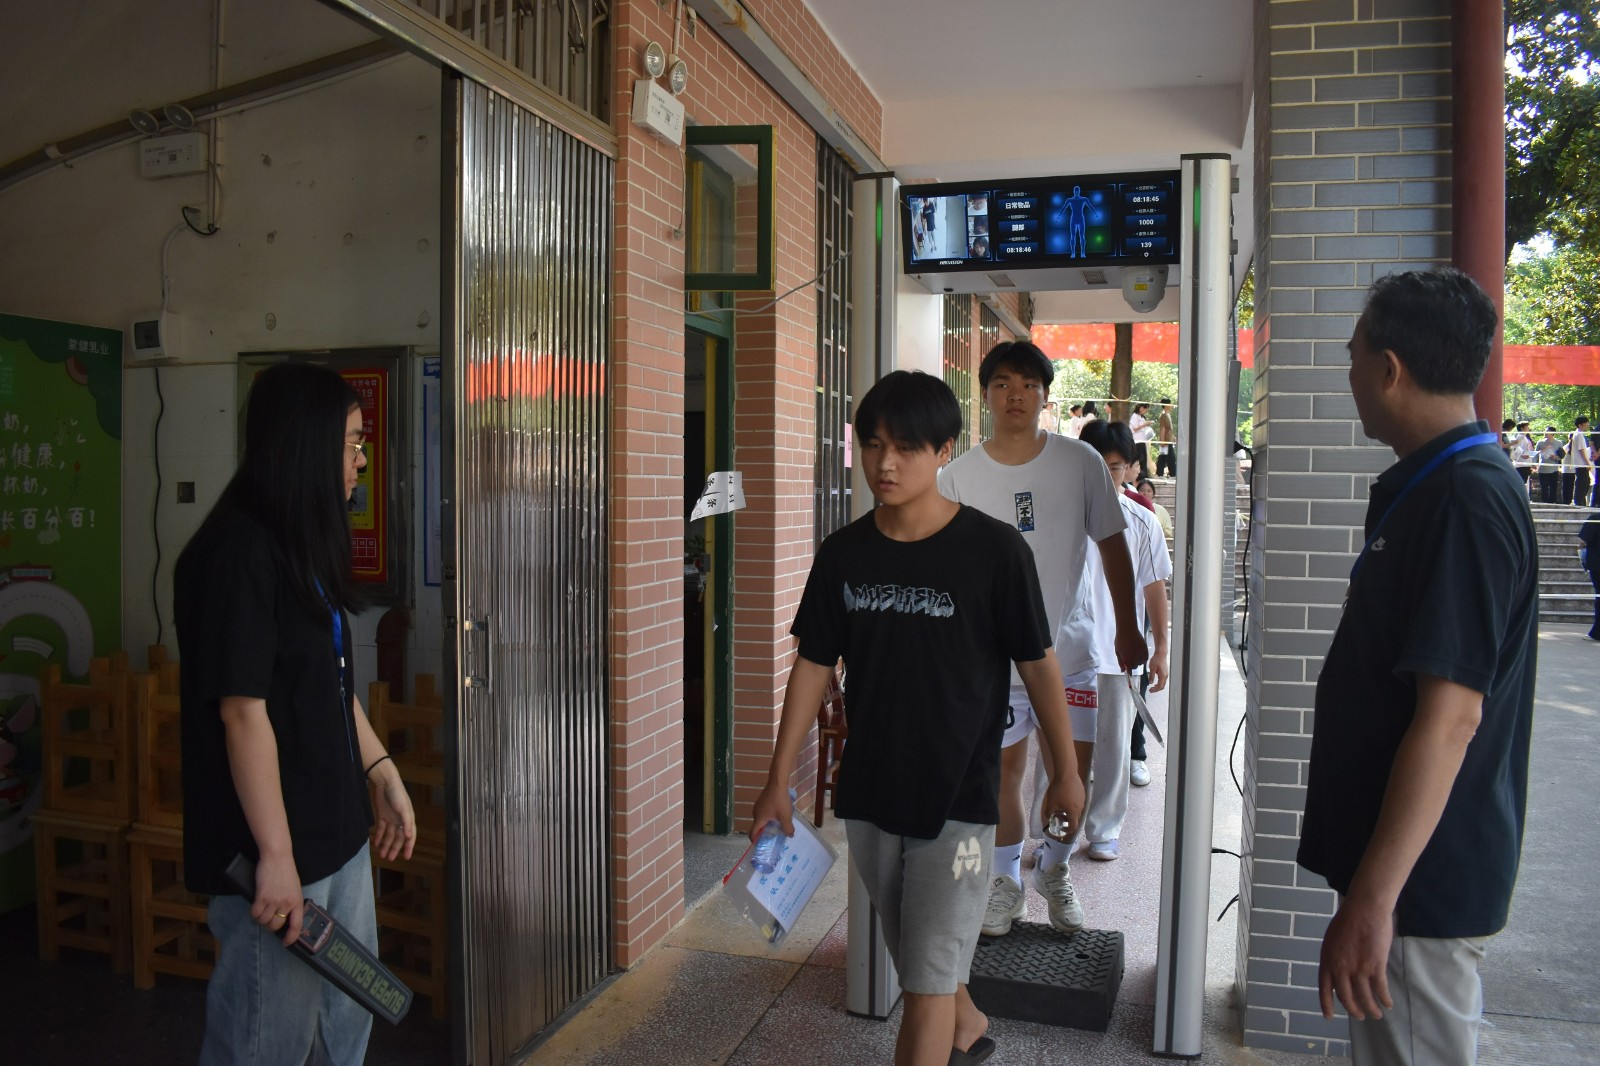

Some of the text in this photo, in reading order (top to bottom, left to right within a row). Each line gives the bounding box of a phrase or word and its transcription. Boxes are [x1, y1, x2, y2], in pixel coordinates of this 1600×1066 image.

[357, 388, 373, 398] 19
[326, 938, 406, 1015] SUPER SCANNER
